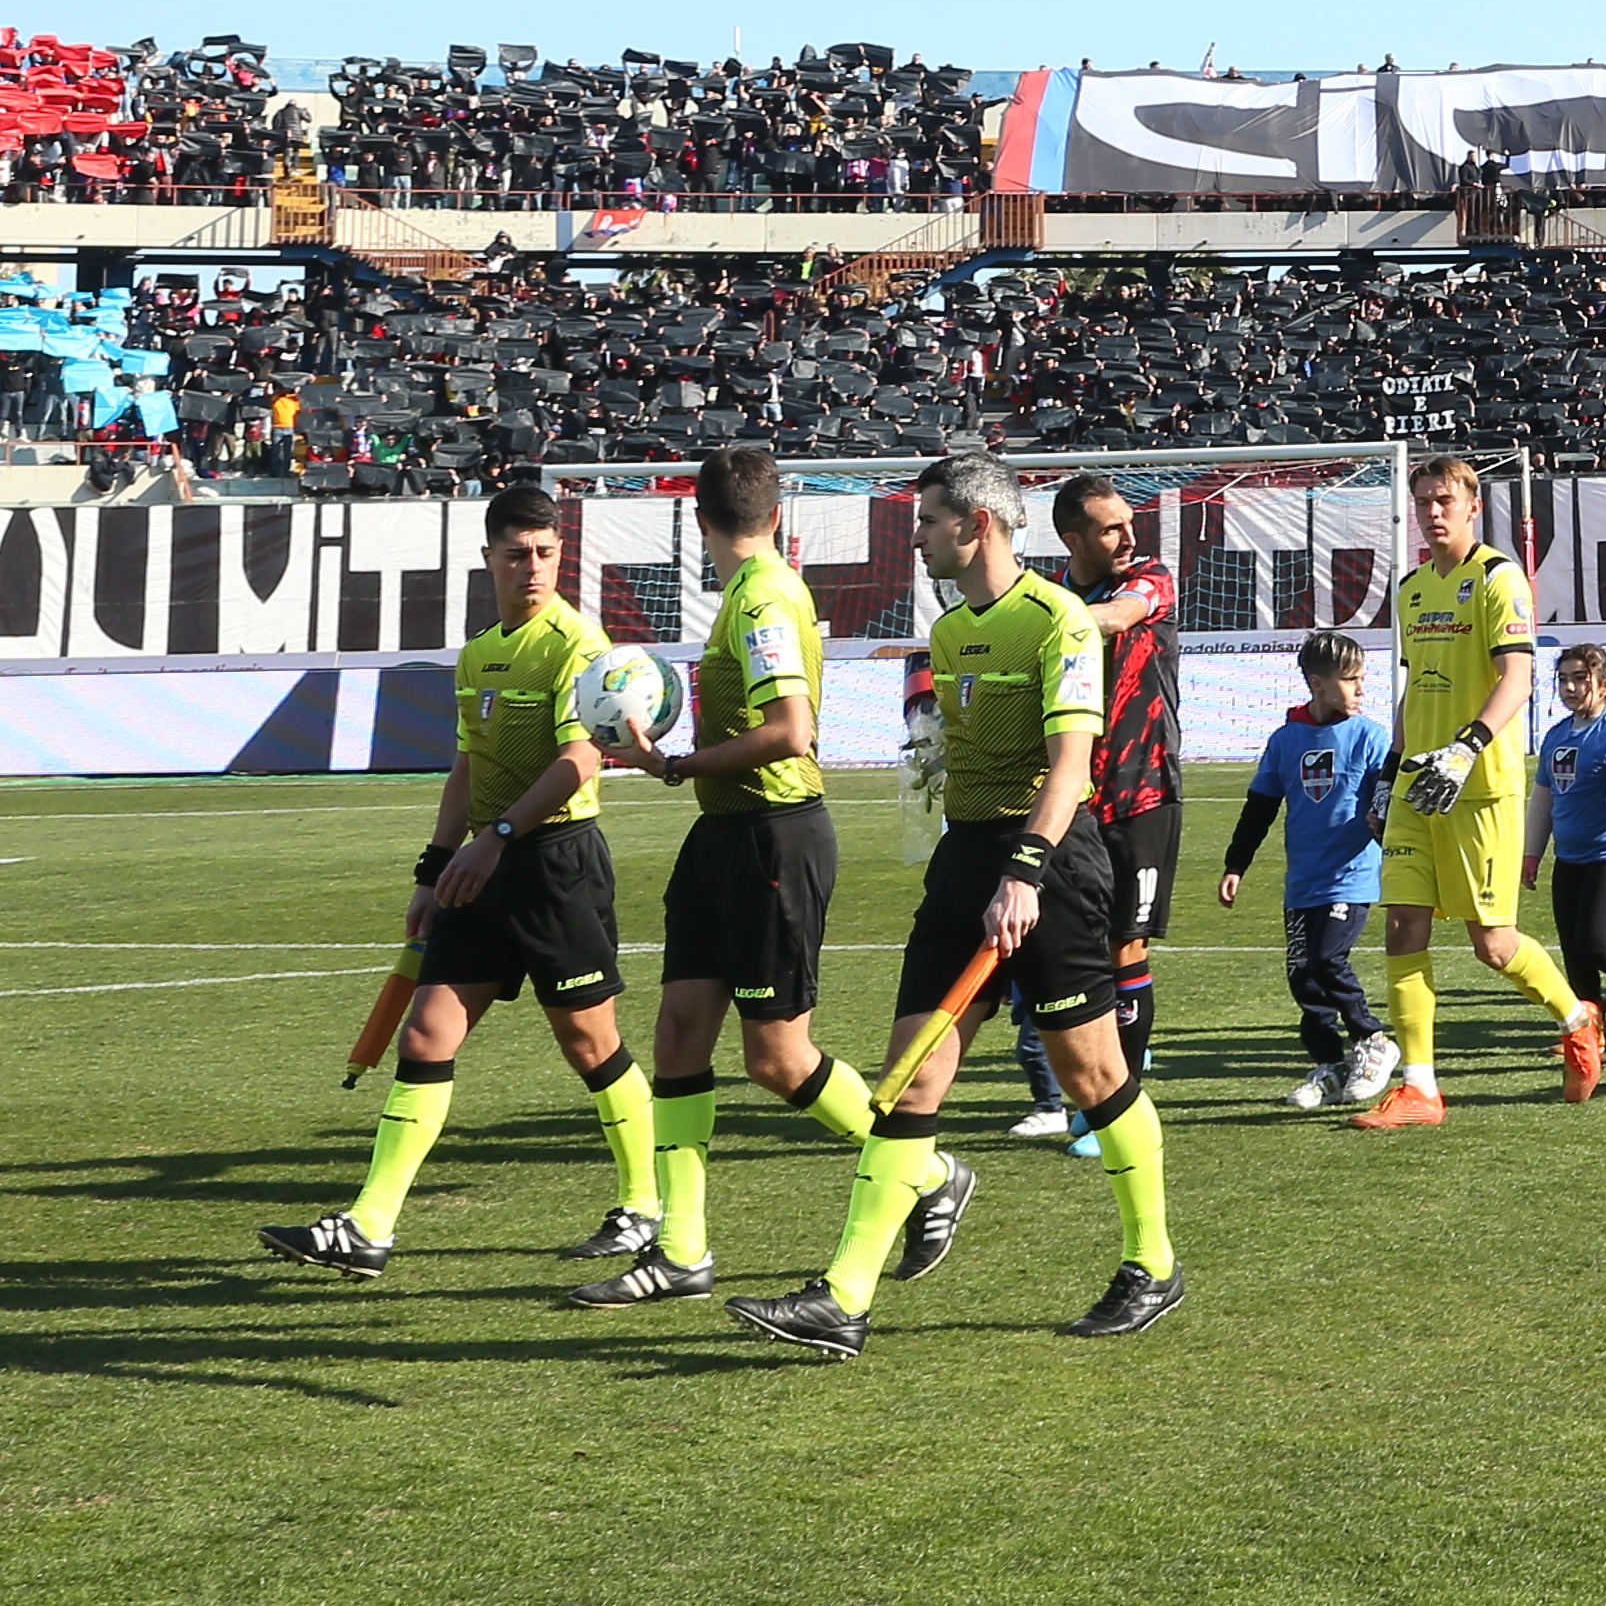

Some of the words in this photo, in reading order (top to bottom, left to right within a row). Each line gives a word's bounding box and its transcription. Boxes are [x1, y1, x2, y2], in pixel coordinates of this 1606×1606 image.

[1414, 396, 1428, 412] E
[556, 969, 605, 992] LEGEA
[734, 986, 776, 999] LEGEA
[1035, 991, 1089, 1014] LEGEA
